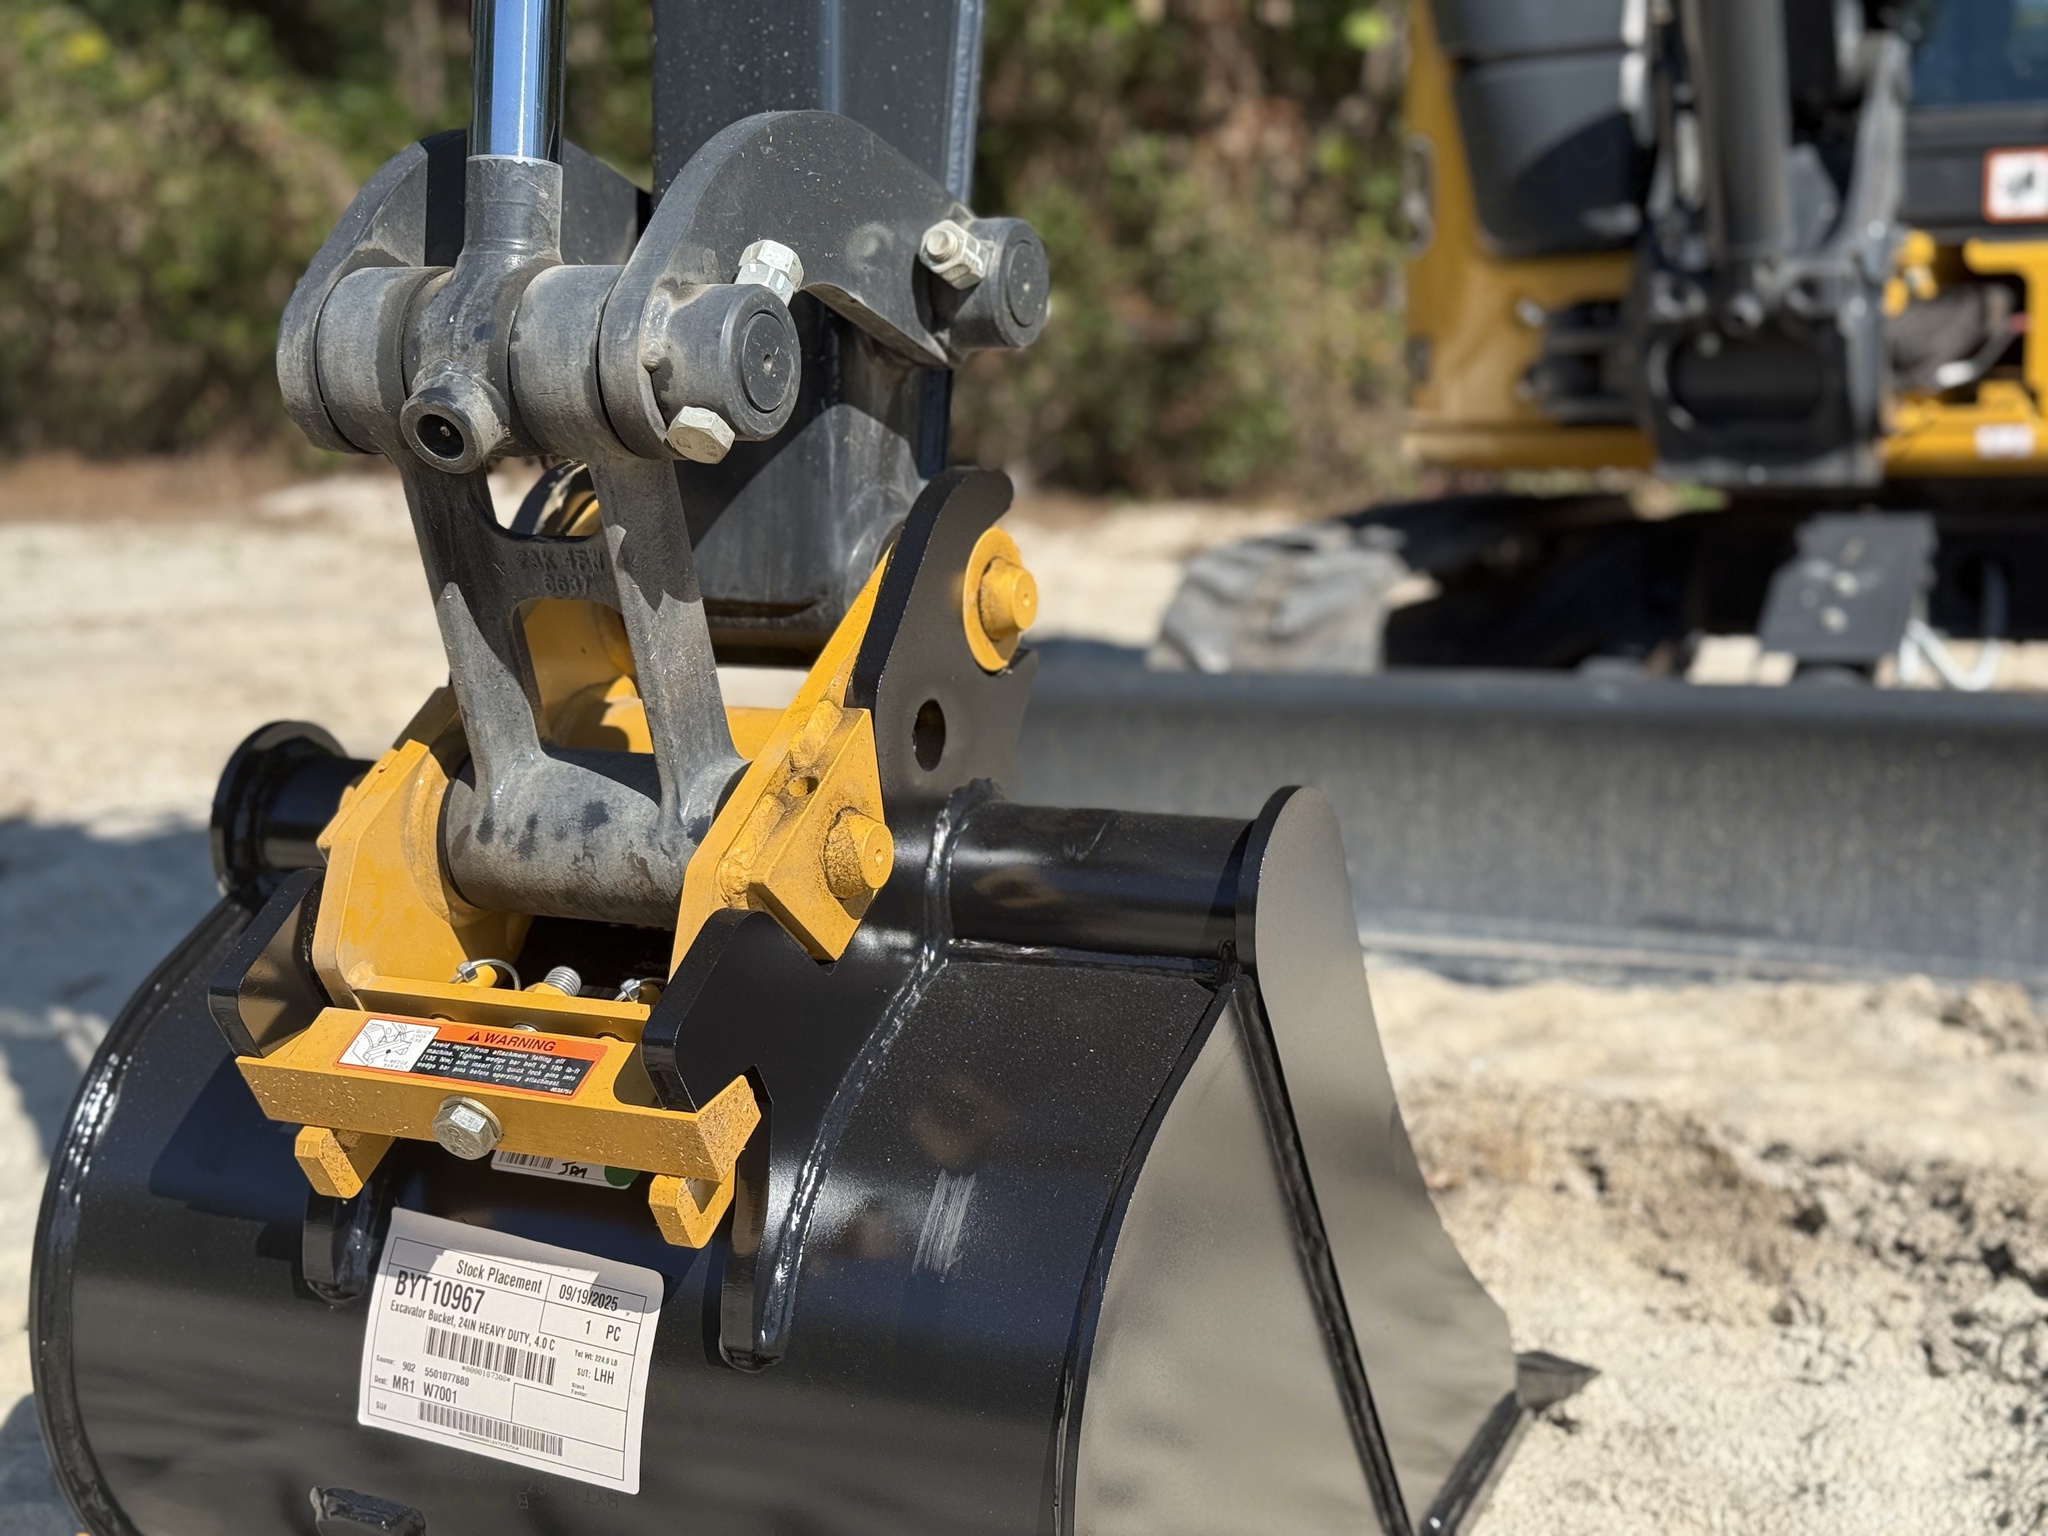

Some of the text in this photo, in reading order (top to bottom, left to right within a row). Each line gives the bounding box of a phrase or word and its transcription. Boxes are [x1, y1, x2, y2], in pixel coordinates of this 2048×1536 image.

[484, 1032, 556, 1051] WARNING
[426, 1048, 454, 1057] machine.
[459, 1052, 482, 1060] Tighten
[485, 1056, 506, 1064] wedge
[523, 1060, 536, 1068] bolt
[492, 1050, 529, 1059] attachment
[531, 1055, 552, 1063] falling
[417, 1062, 436, 1070] wedge
[469, 1068, 489, 1076] before
[492, 1071, 523, 1082] operating
[524, 1077, 560, 1086] attachment.
[456, 1259, 542, 1294] Stock Placement
[394, 1270, 485, 1314] BYT10967
[559, 1284, 618, 1311] 09/19/2025
[390, 1300, 555, 1351] Excavator Bucket, 24IN HEAVY DUTY, 4.0 C
[585, 1320, 621, 1342] 1 PC
[402, 1361, 416, 1373] 902
[577, 1367, 615, 1385] SUT: LHH
[374, 1374, 457, 1404] Dest: MR1 W7001
